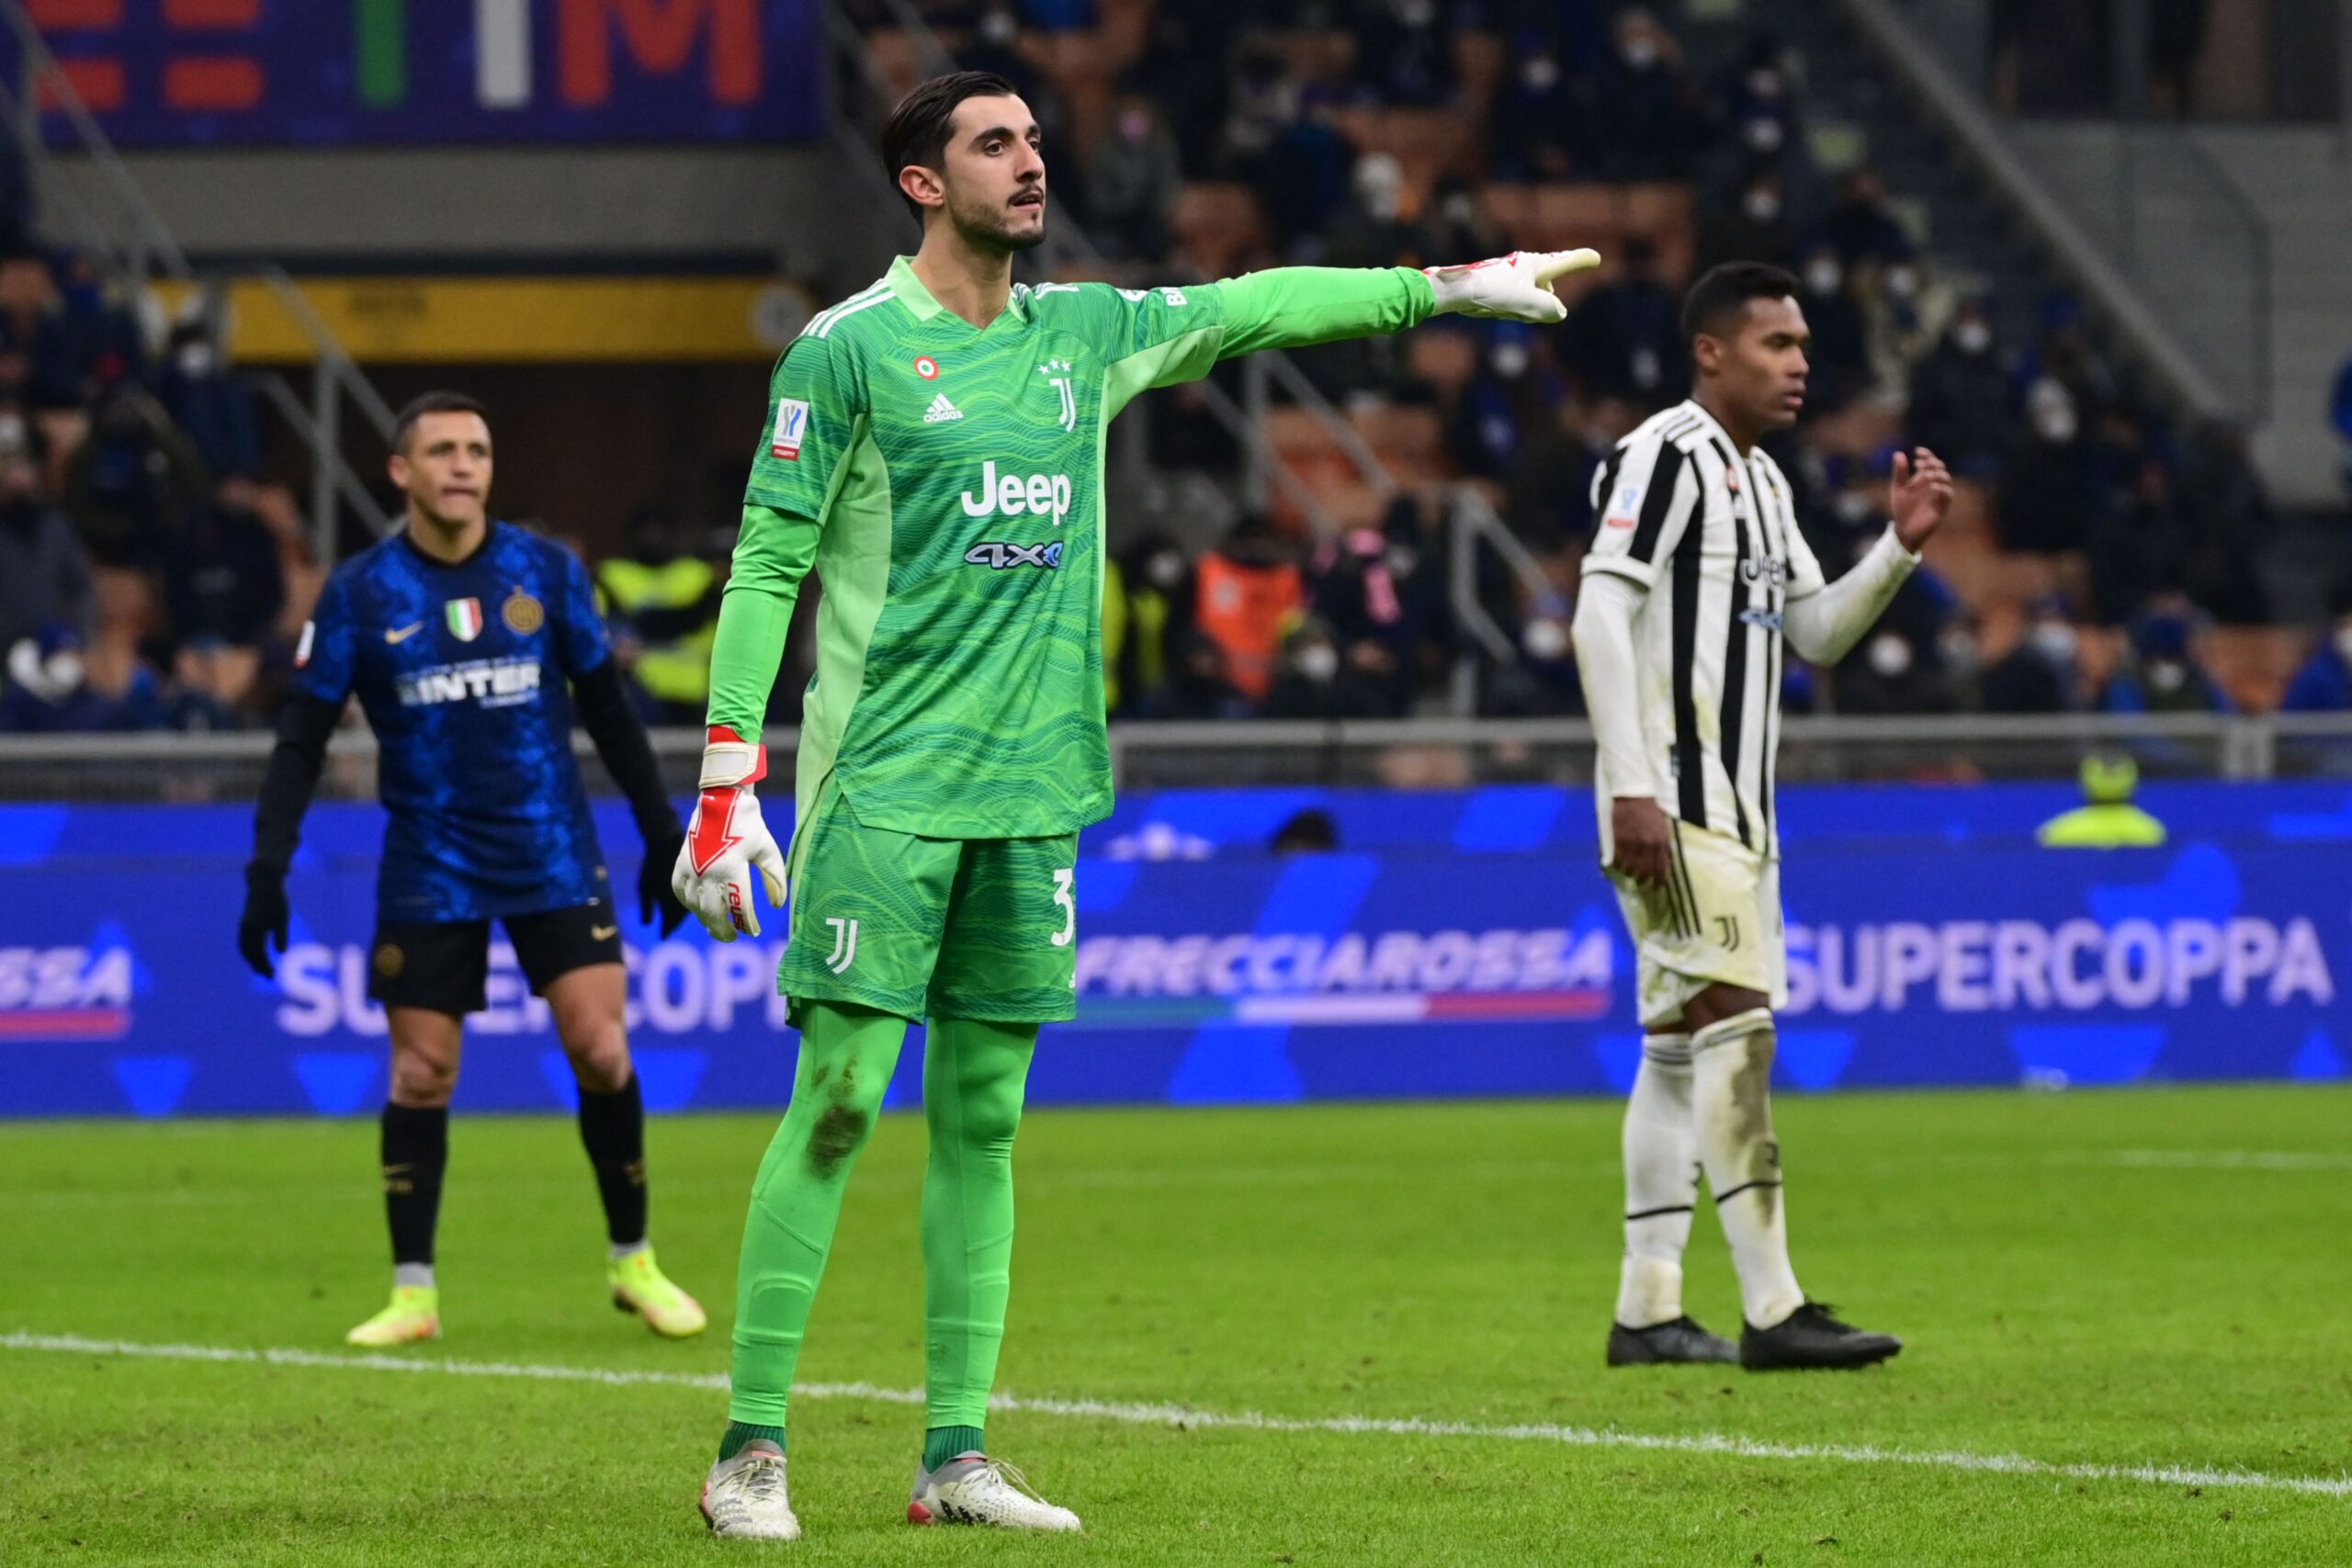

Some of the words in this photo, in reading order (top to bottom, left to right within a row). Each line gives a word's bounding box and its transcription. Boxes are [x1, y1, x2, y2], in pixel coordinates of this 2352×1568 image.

[923, 410, 963, 423] adidas
[961, 461, 1071, 525] Jeep
[1075, 928, 1612, 996] FRECCIAROSSA
